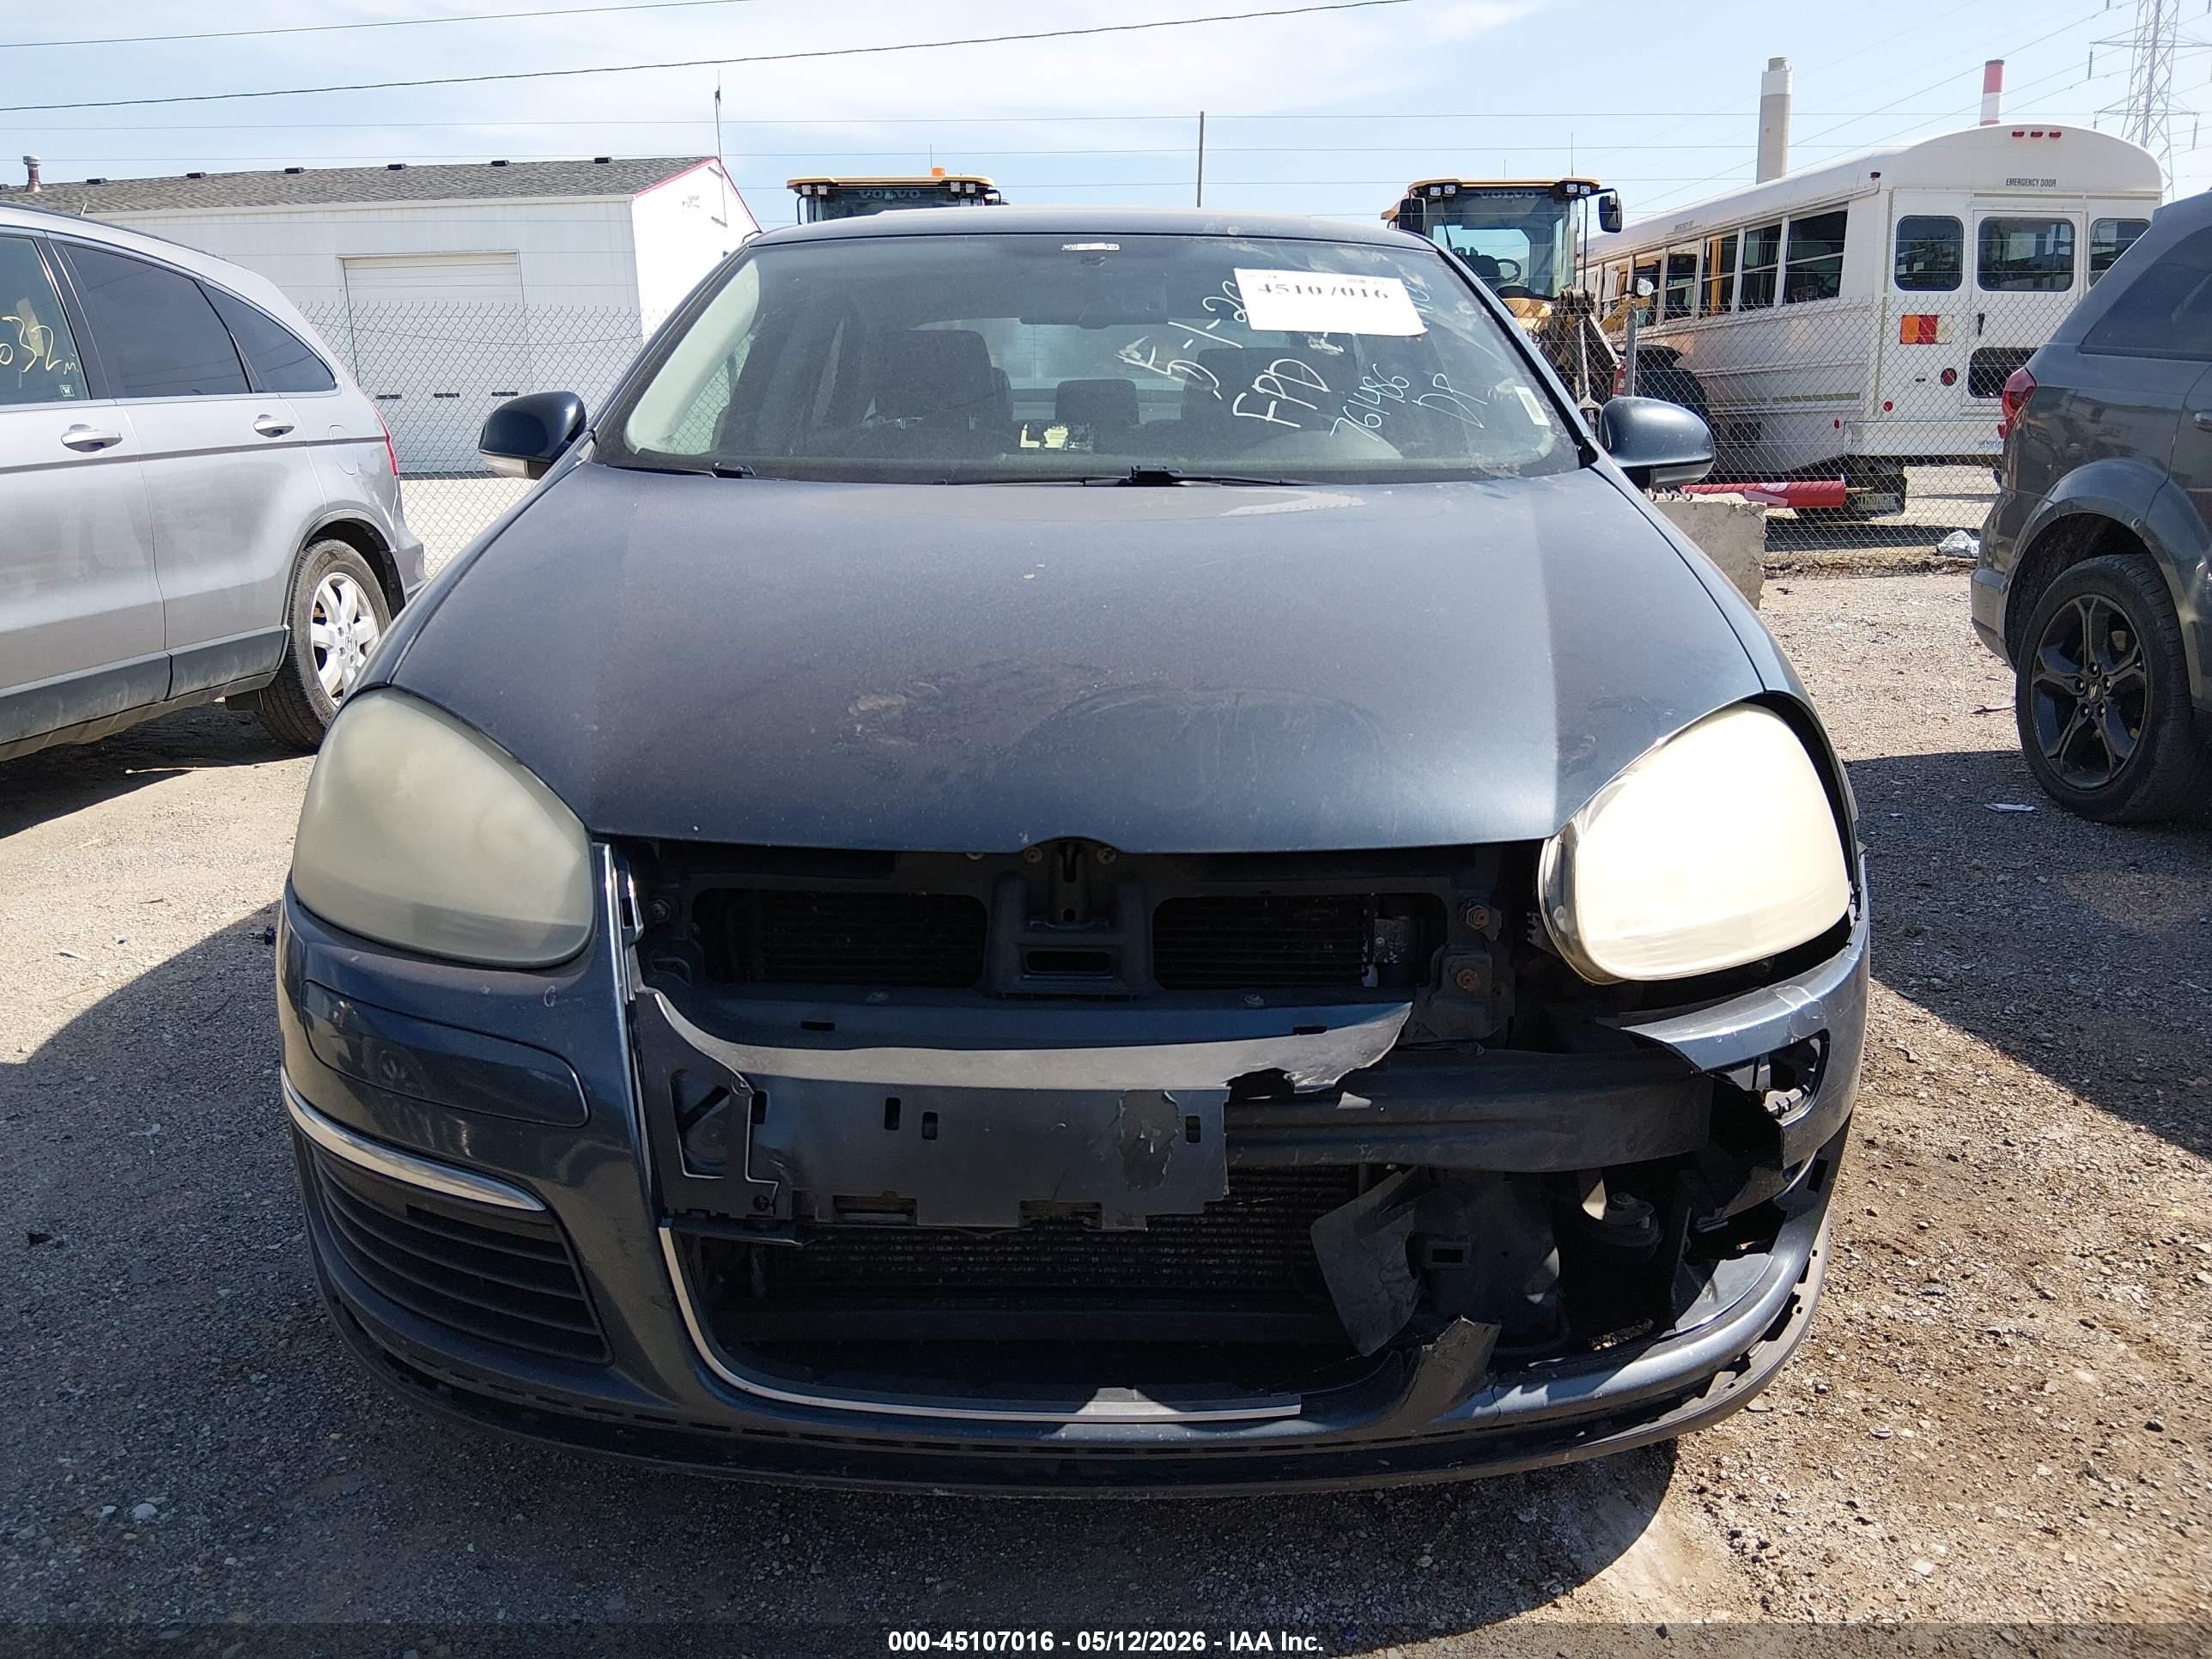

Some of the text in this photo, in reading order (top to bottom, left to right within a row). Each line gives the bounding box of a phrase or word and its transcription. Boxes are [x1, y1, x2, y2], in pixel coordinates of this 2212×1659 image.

[2005, 178, 2057, 187] EMERGENCY DOOR
[857, 189, 921, 199] VOLVO
[1232, 357, 1332, 428] FPD
